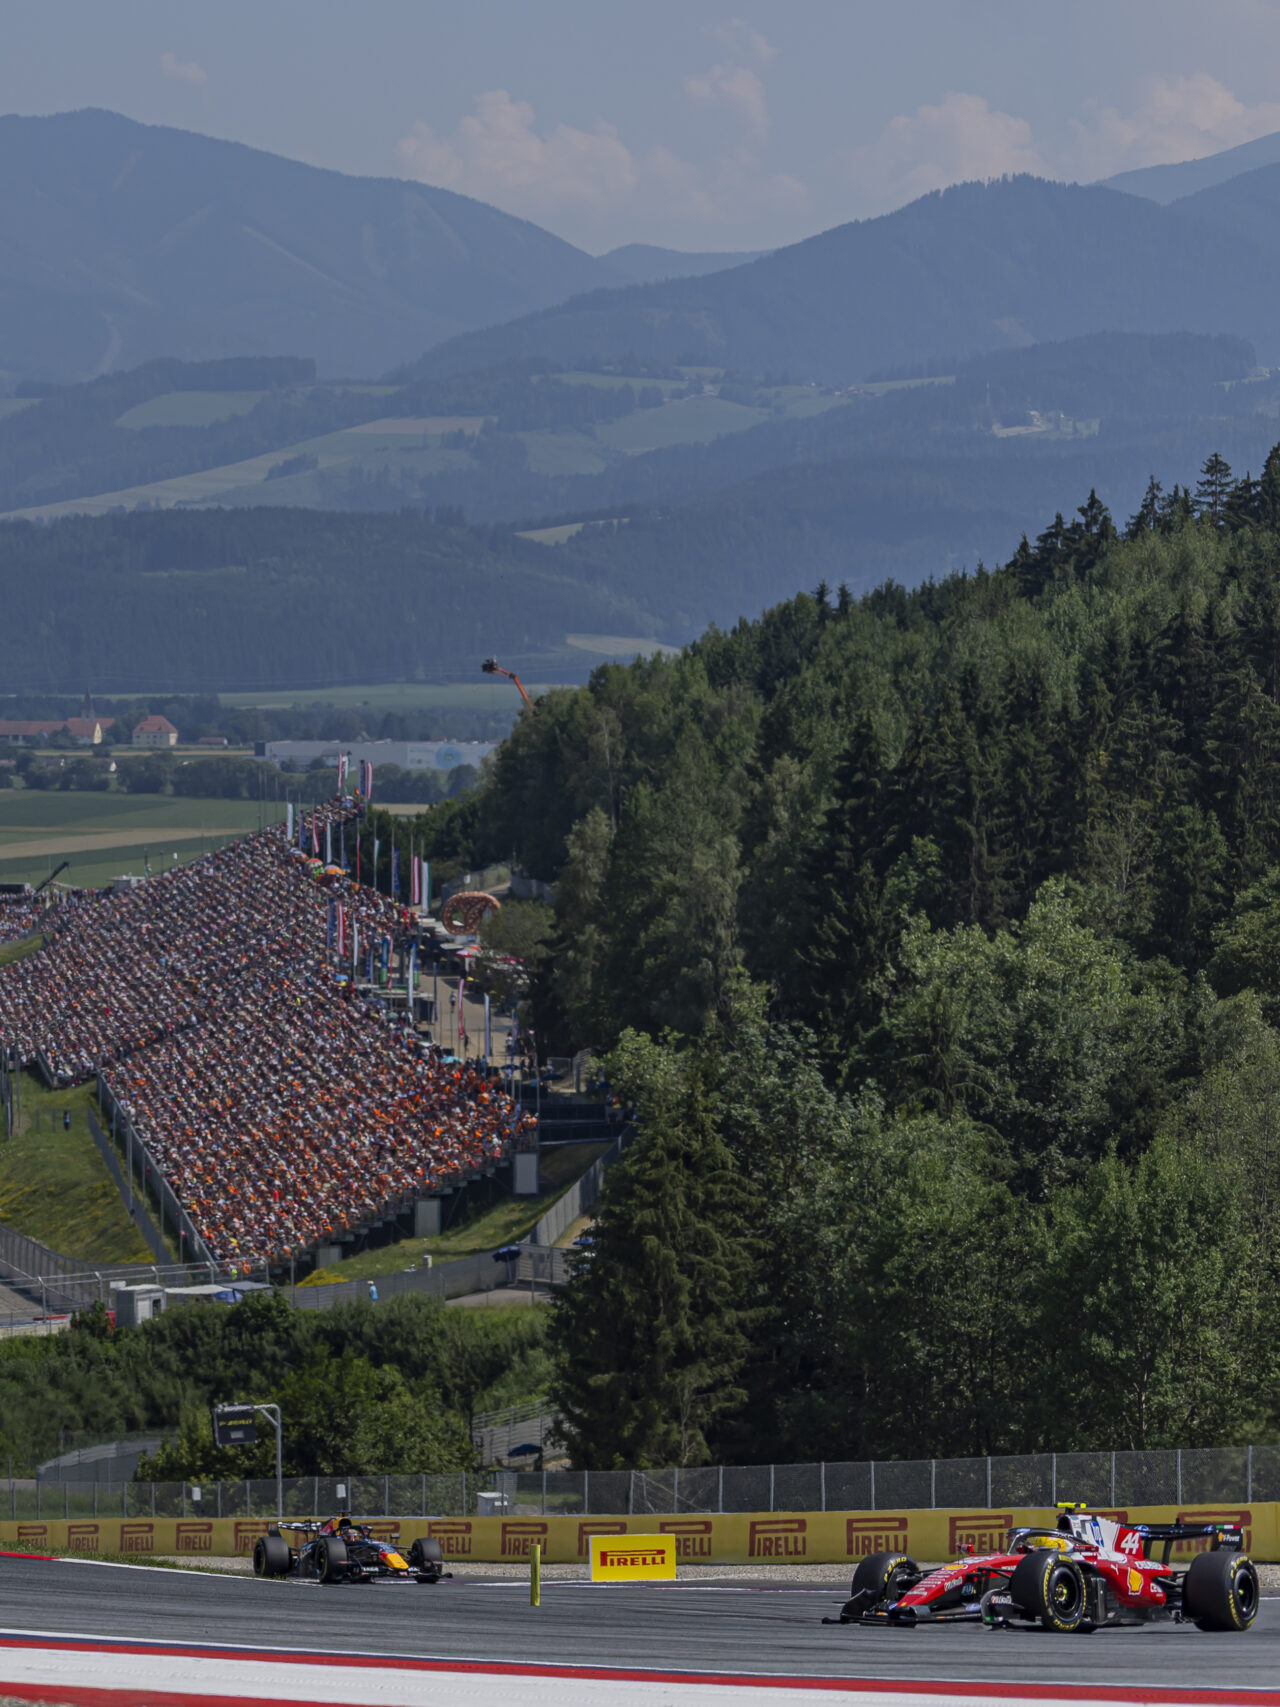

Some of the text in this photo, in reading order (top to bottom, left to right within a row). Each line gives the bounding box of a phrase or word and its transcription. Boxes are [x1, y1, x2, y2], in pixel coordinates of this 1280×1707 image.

[68, 1523, 99, 1551] PIRELLI
[120, 1523, 154, 1552] PIRELLI
[176, 1522, 213, 1551] PIRELLI
[234, 1521, 268, 1552] PIRE
[428, 1521, 472, 1554] PRELLI
[660, 1521, 712, 1556] PRELLI
[748, 1519, 807, 1557] PIRELLI
[846, 1517, 908, 1555] PIRELLI
[1120, 1532, 1140, 1554] 44
[1222, 1534, 1240, 1542] V-Power
[600, 1549, 666, 1567] PIRELLI
